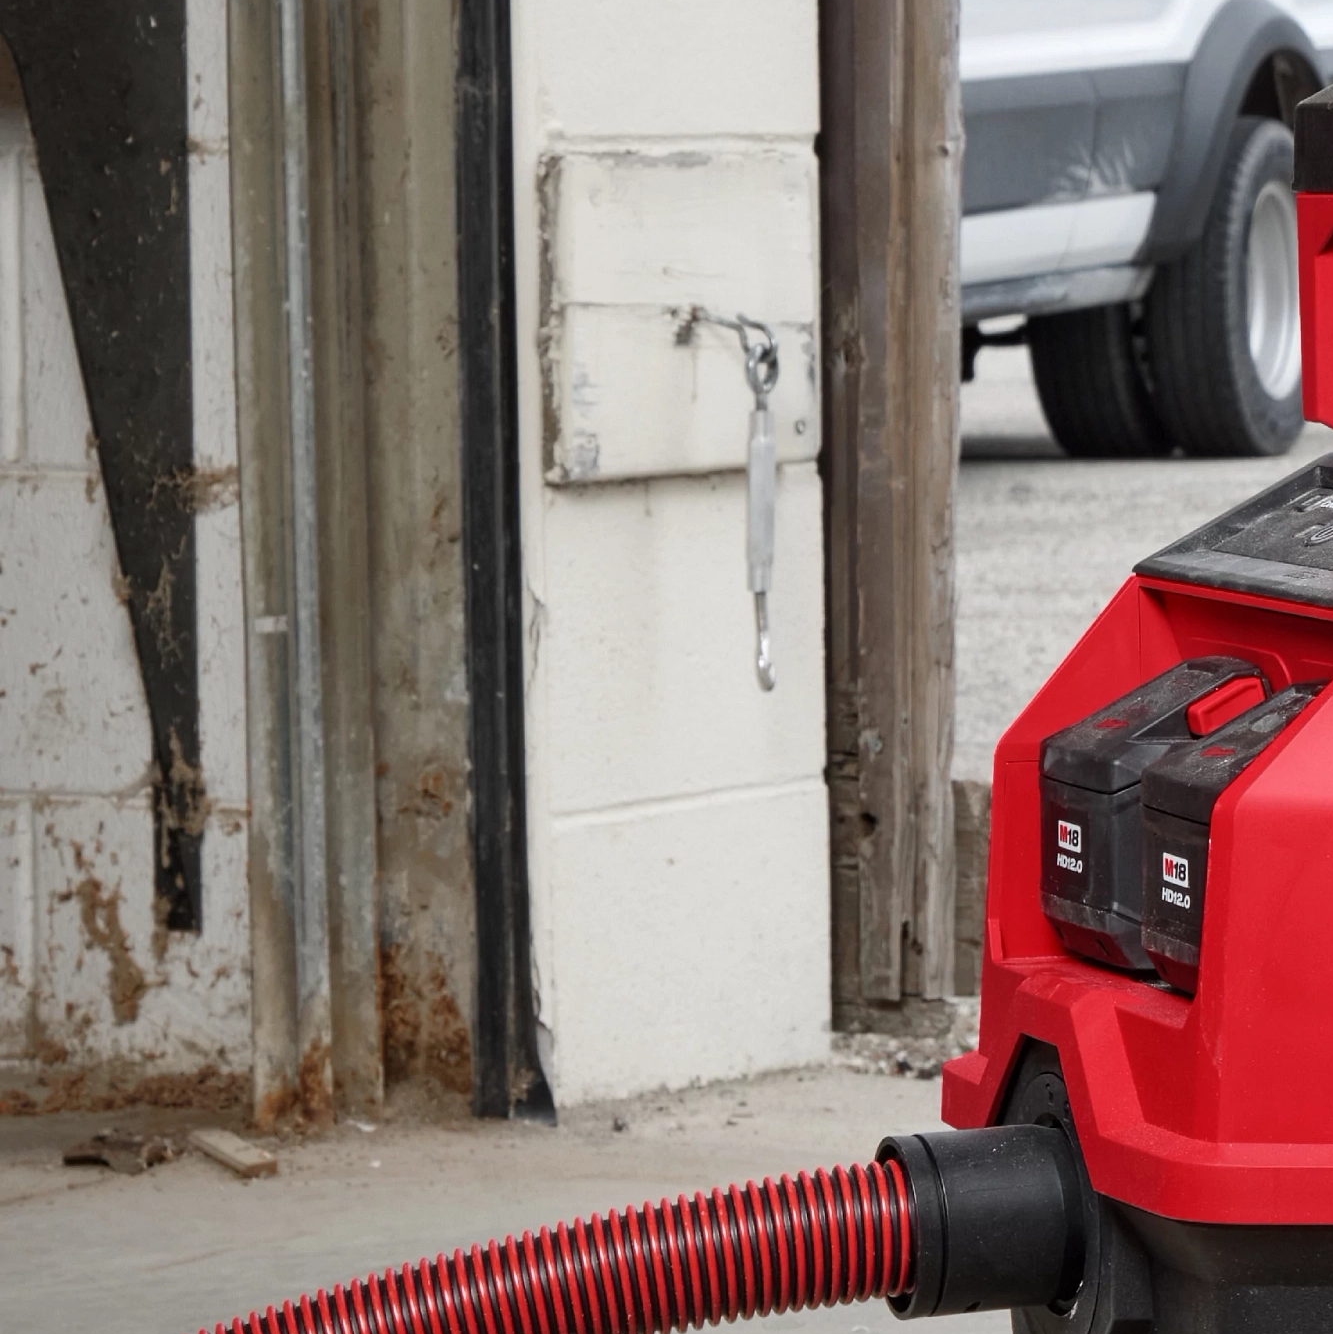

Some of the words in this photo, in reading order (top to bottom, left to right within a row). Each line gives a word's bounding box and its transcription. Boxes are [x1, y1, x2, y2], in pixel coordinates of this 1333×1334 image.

[1059, 824, 1080, 847] M18
[1056, 853, 1083, 874] HD12.0
[1164, 858, 1187, 882] M18
[1161, 887, 1191, 909] HD12.0
